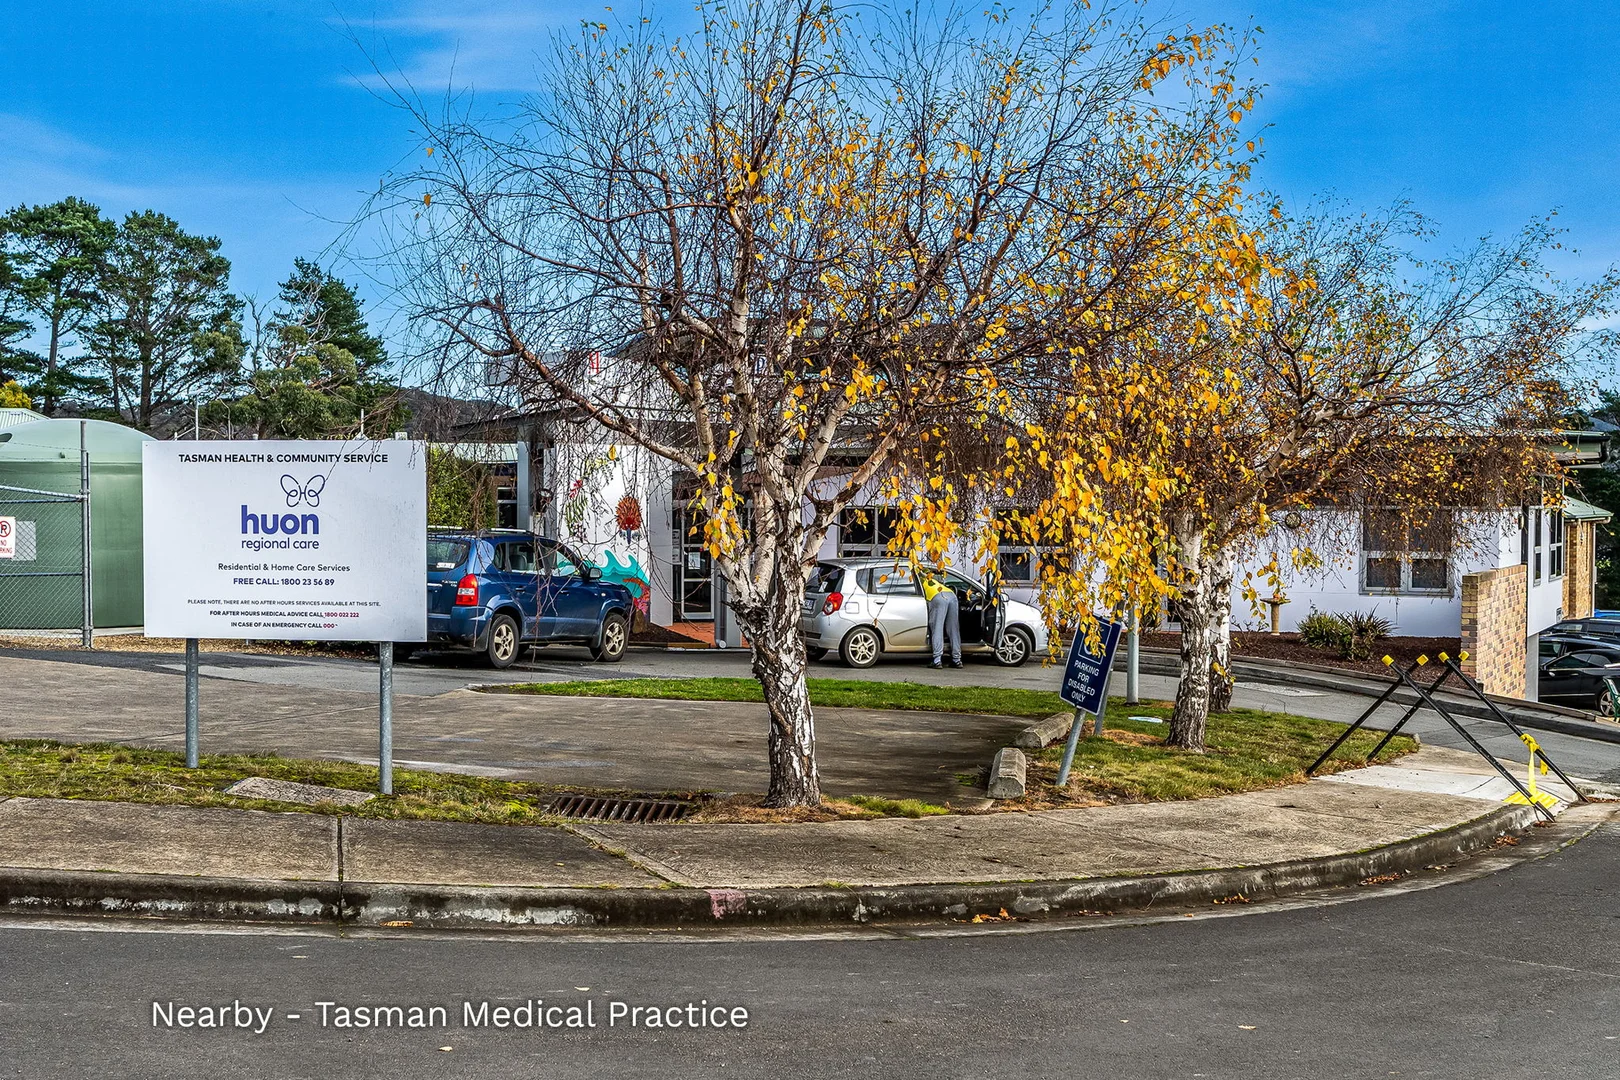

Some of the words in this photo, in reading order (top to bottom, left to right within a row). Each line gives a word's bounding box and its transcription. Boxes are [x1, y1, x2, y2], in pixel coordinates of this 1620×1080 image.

[178, 454, 222, 462] TASMAN
[224, 454, 264, 462] HEALTH
[266, 454, 274, 462] &
[276, 454, 342, 463] COMMUNITY
[344, 454, 388, 463] SERVICE
[241, 505, 320, 534] huon
[241, 537, 290, 551] regional
[292, 540, 319, 549] care
[1074, 660, 1100, 676] PARKING
[1077, 672, 1089, 683] FOR
[1068, 678, 1095, 696] DISABLED
[1071, 690, 1086, 702] ONLY
